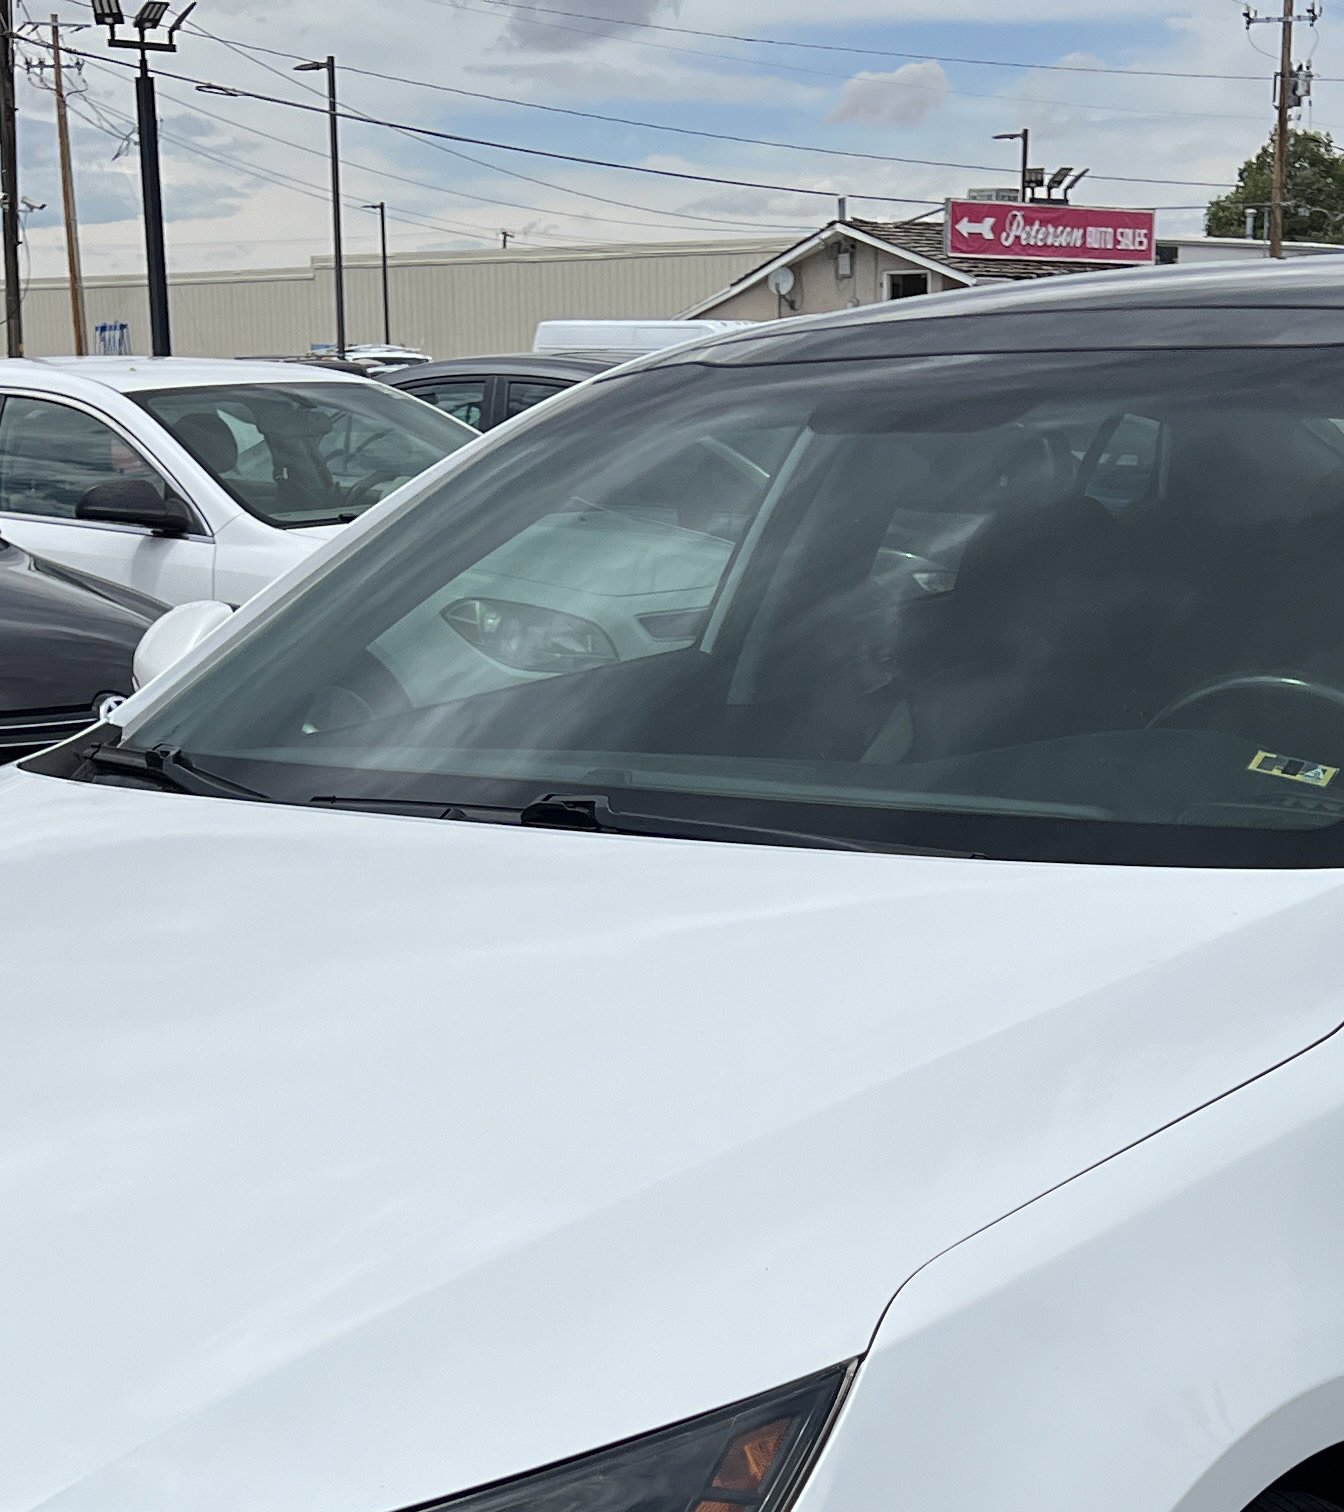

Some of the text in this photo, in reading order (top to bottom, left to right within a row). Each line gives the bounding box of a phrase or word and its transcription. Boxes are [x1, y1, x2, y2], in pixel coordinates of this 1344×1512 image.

[1001, 211, 1148, 250] Peterson AUTO SALES
